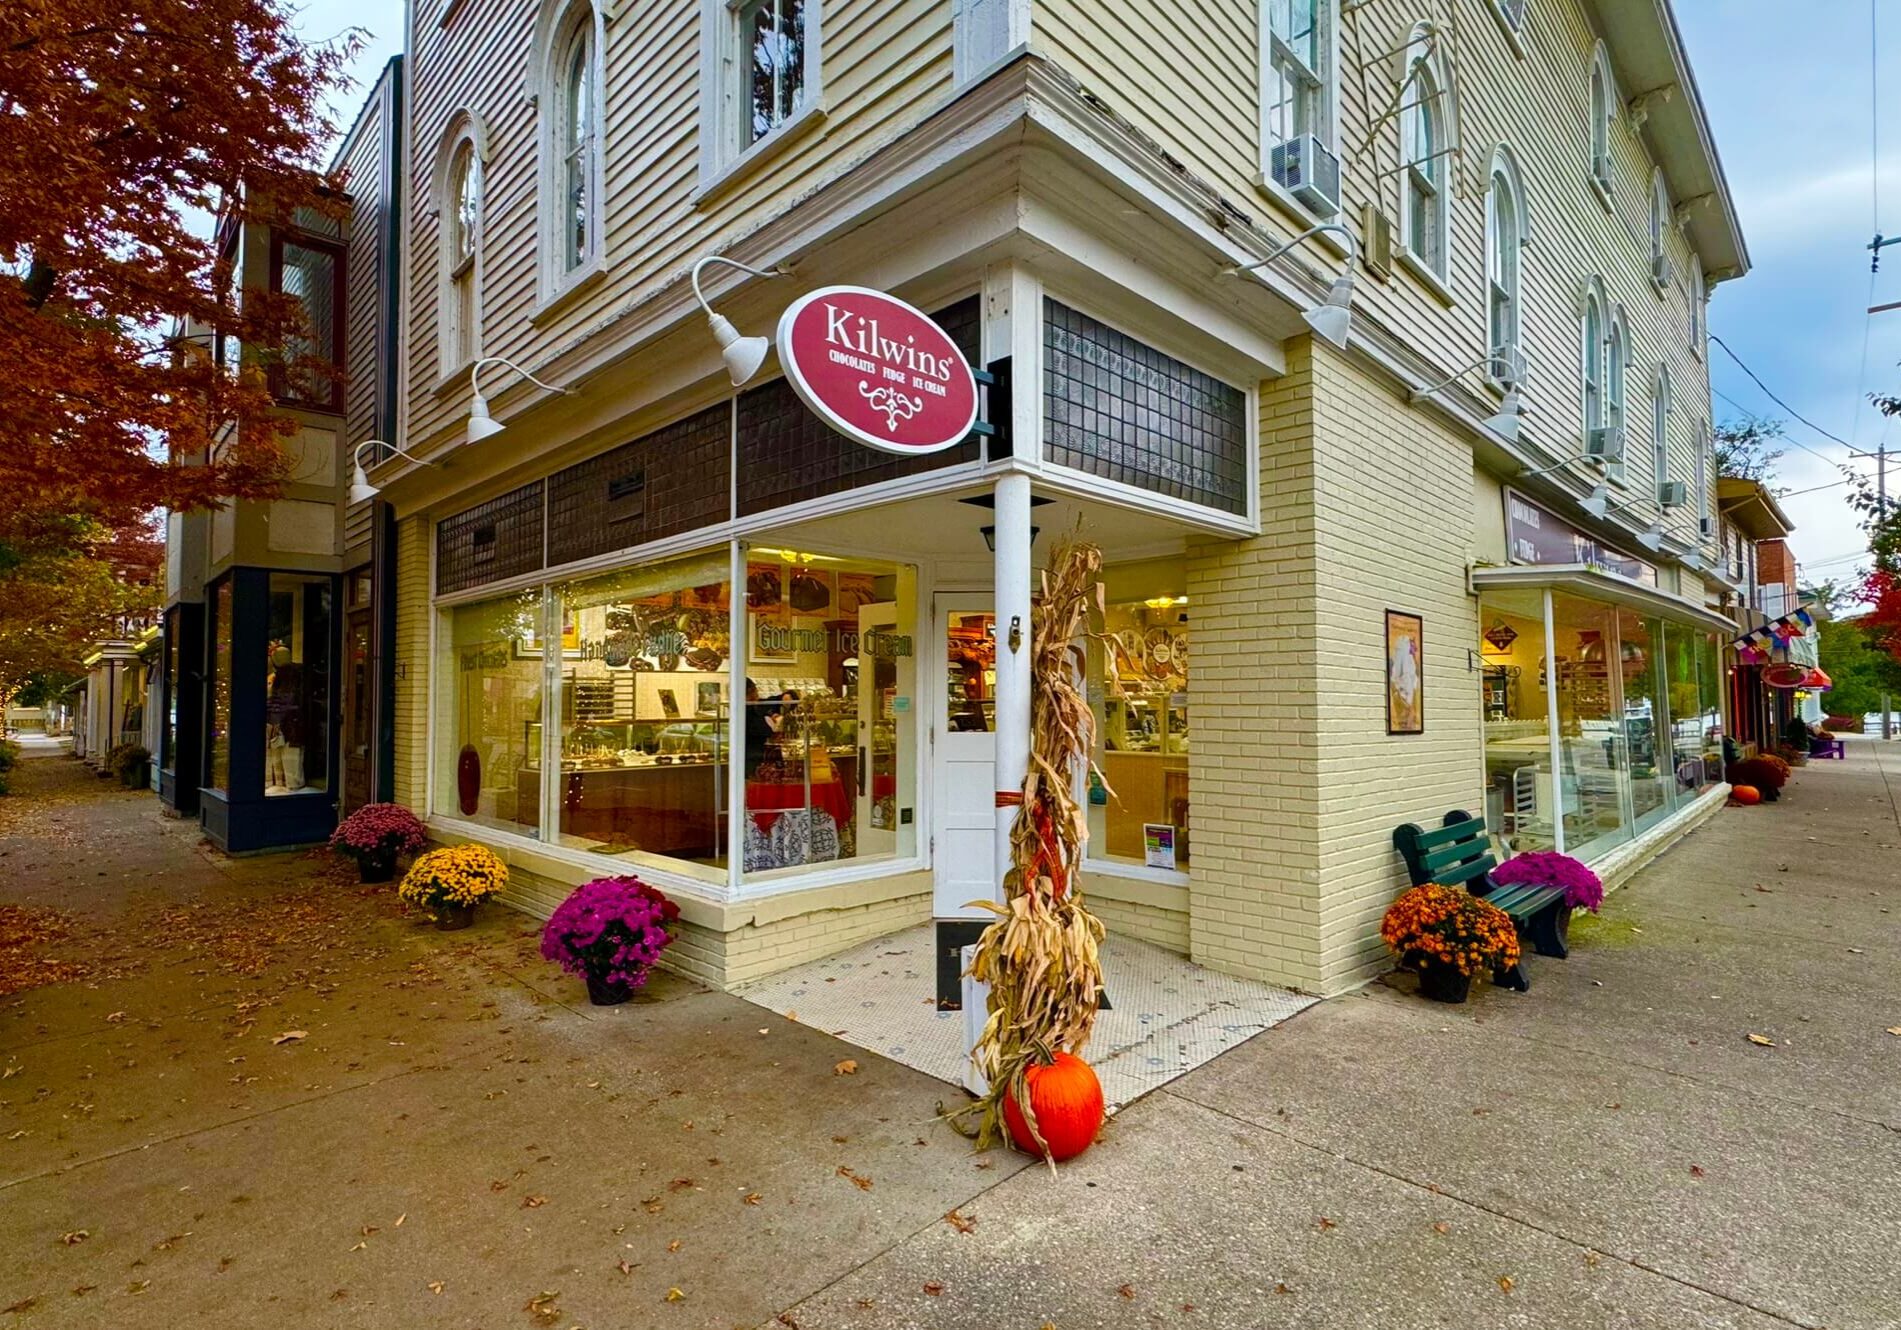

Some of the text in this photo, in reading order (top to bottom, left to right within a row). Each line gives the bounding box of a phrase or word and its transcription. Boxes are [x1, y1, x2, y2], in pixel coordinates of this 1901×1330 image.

[823, 302, 951, 381] Kilwins
[828, 348, 946, 397] CHOCOLATES FUDGE ICE CREAM
[756, 622, 913, 658] Gourmet Ice Cream
